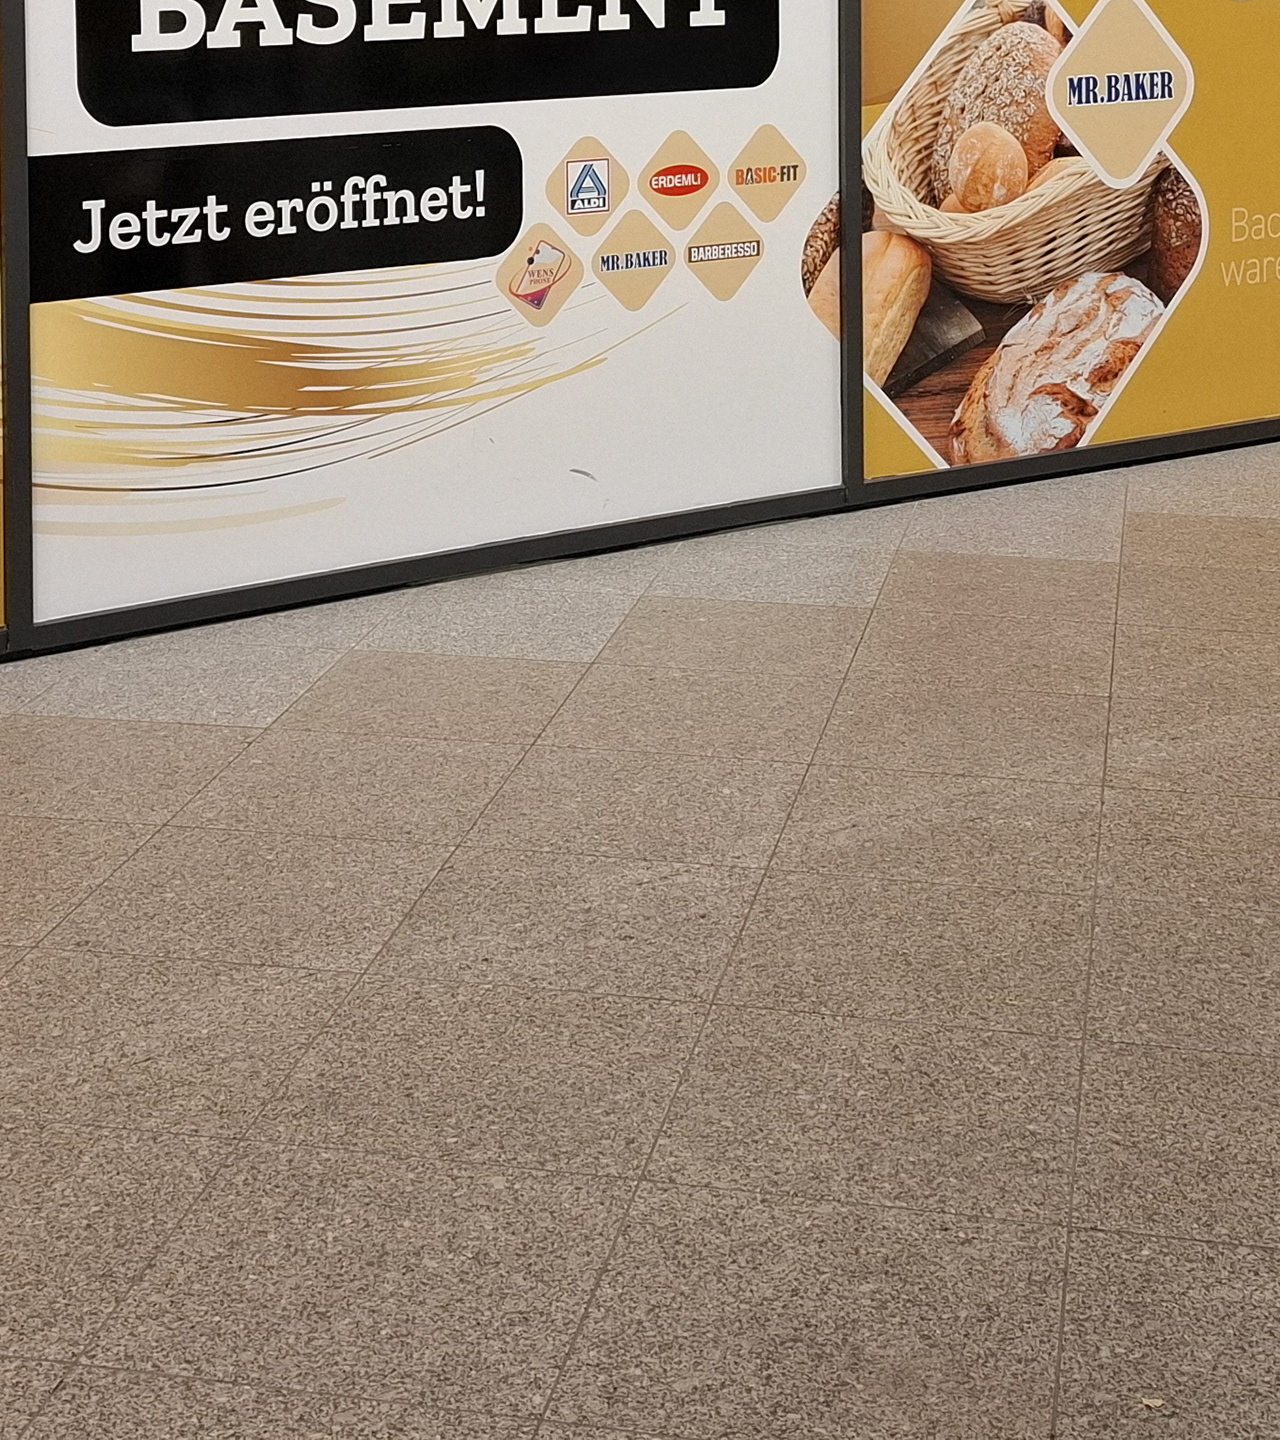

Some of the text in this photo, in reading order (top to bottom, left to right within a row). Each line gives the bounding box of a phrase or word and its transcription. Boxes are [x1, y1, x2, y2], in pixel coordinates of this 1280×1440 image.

[72, 169, 488, 254] Jetzt eröffnet!
[573, 197, 604, 210] ALDI
[691, 241, 758, 261] BARBERESSO
[527, 268, 554, 279] WENS
